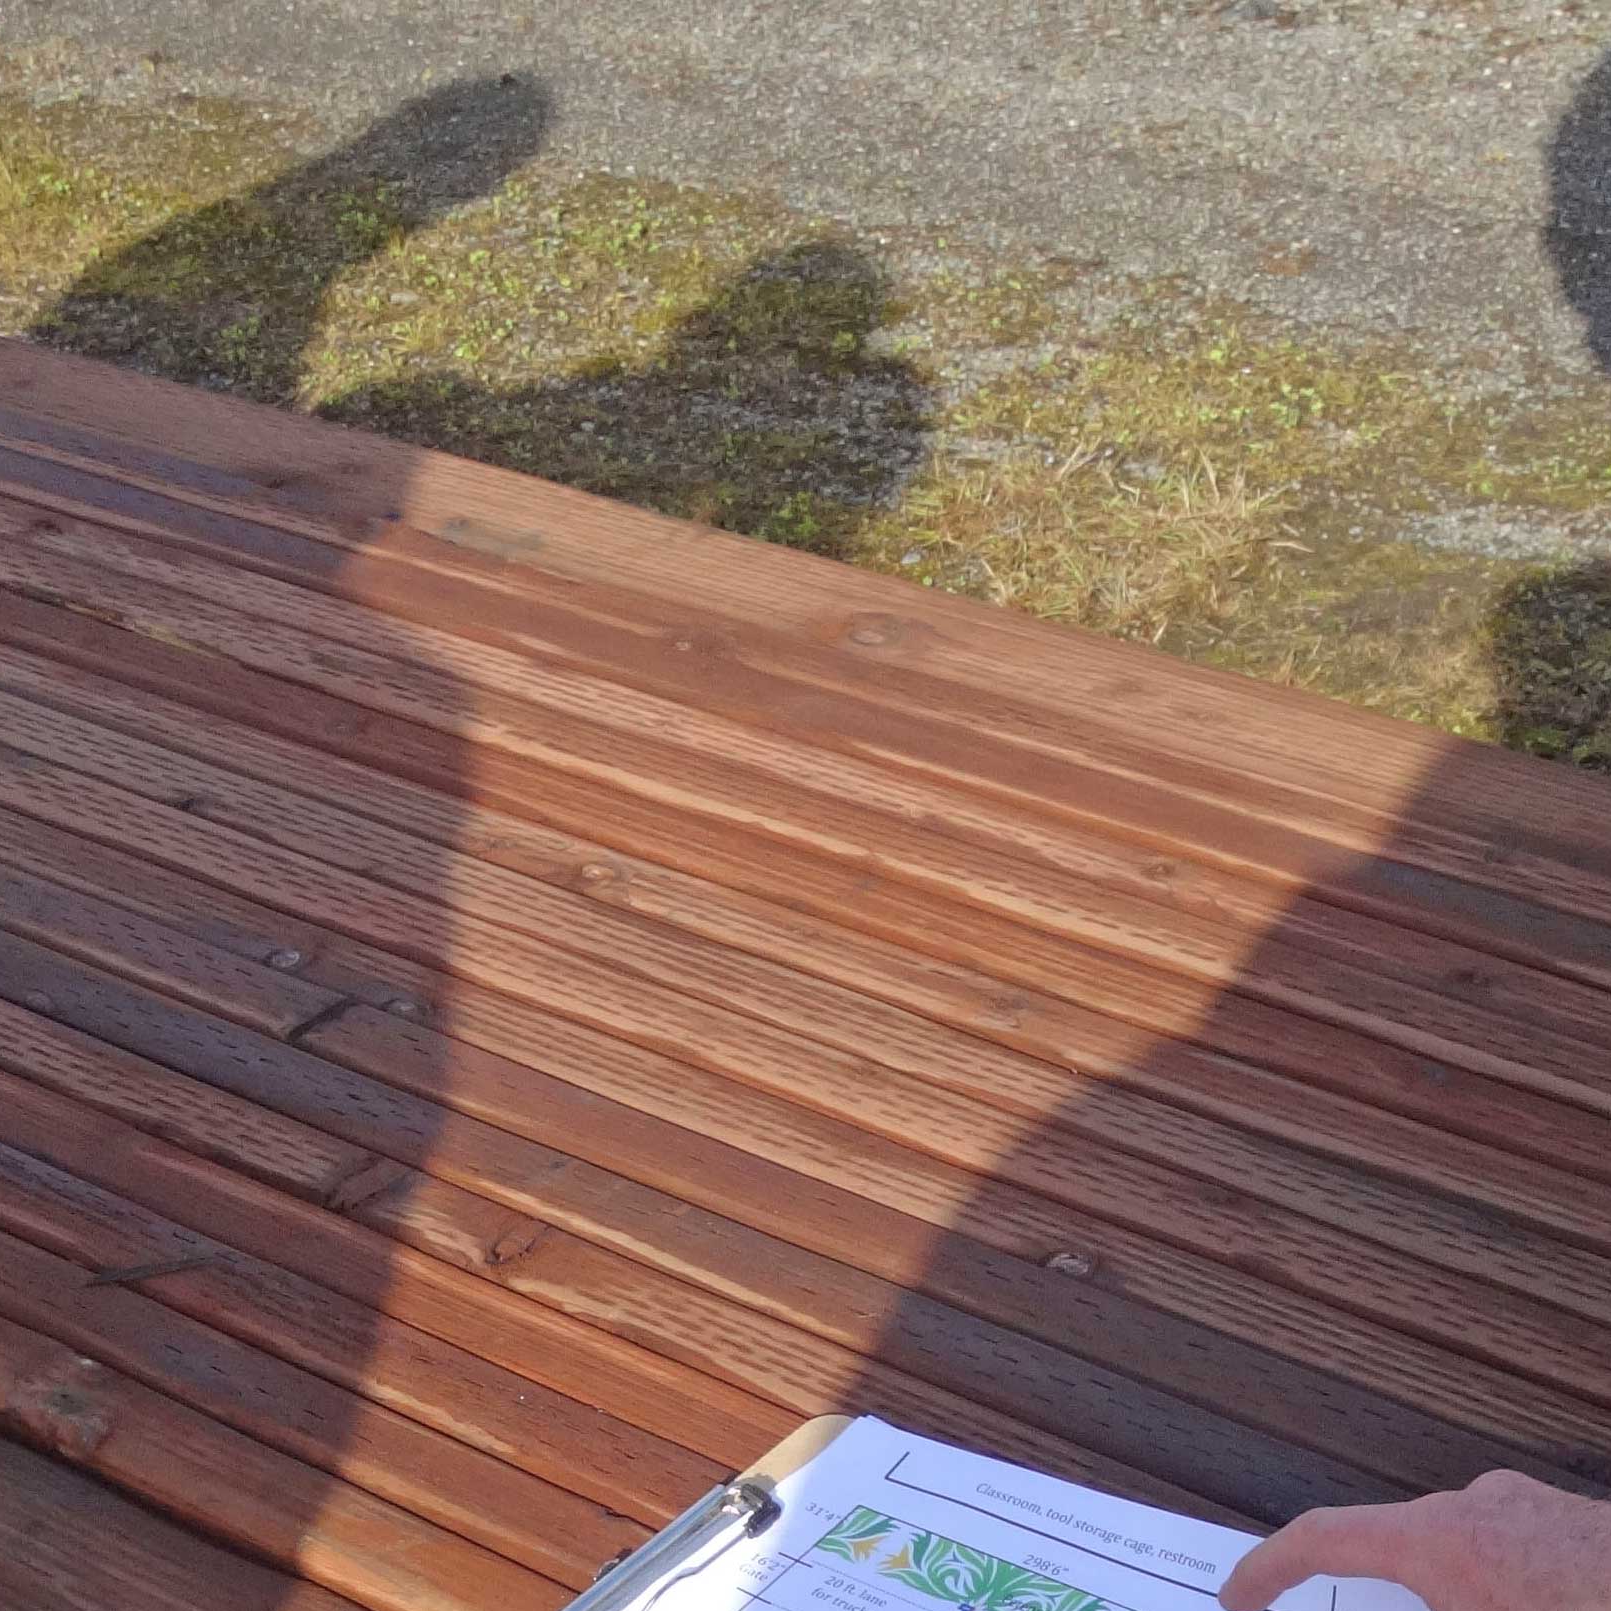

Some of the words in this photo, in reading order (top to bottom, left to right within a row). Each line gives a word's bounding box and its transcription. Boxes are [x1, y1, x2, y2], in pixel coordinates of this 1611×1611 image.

[975, 1482, 1043, 1516] Classroom,
[1045, 1507, 1073, 1526] tool
[1072, 1519, 1123, 1544] storage
[1123, 1535, 1155, 1557] cage,
[1157, 1546, 1218, 1575] restroom
[810, 1587, 832, 1602] for
[824, 1574, 844, 1590] 20
[859, 1588, 888, 1608] lane
